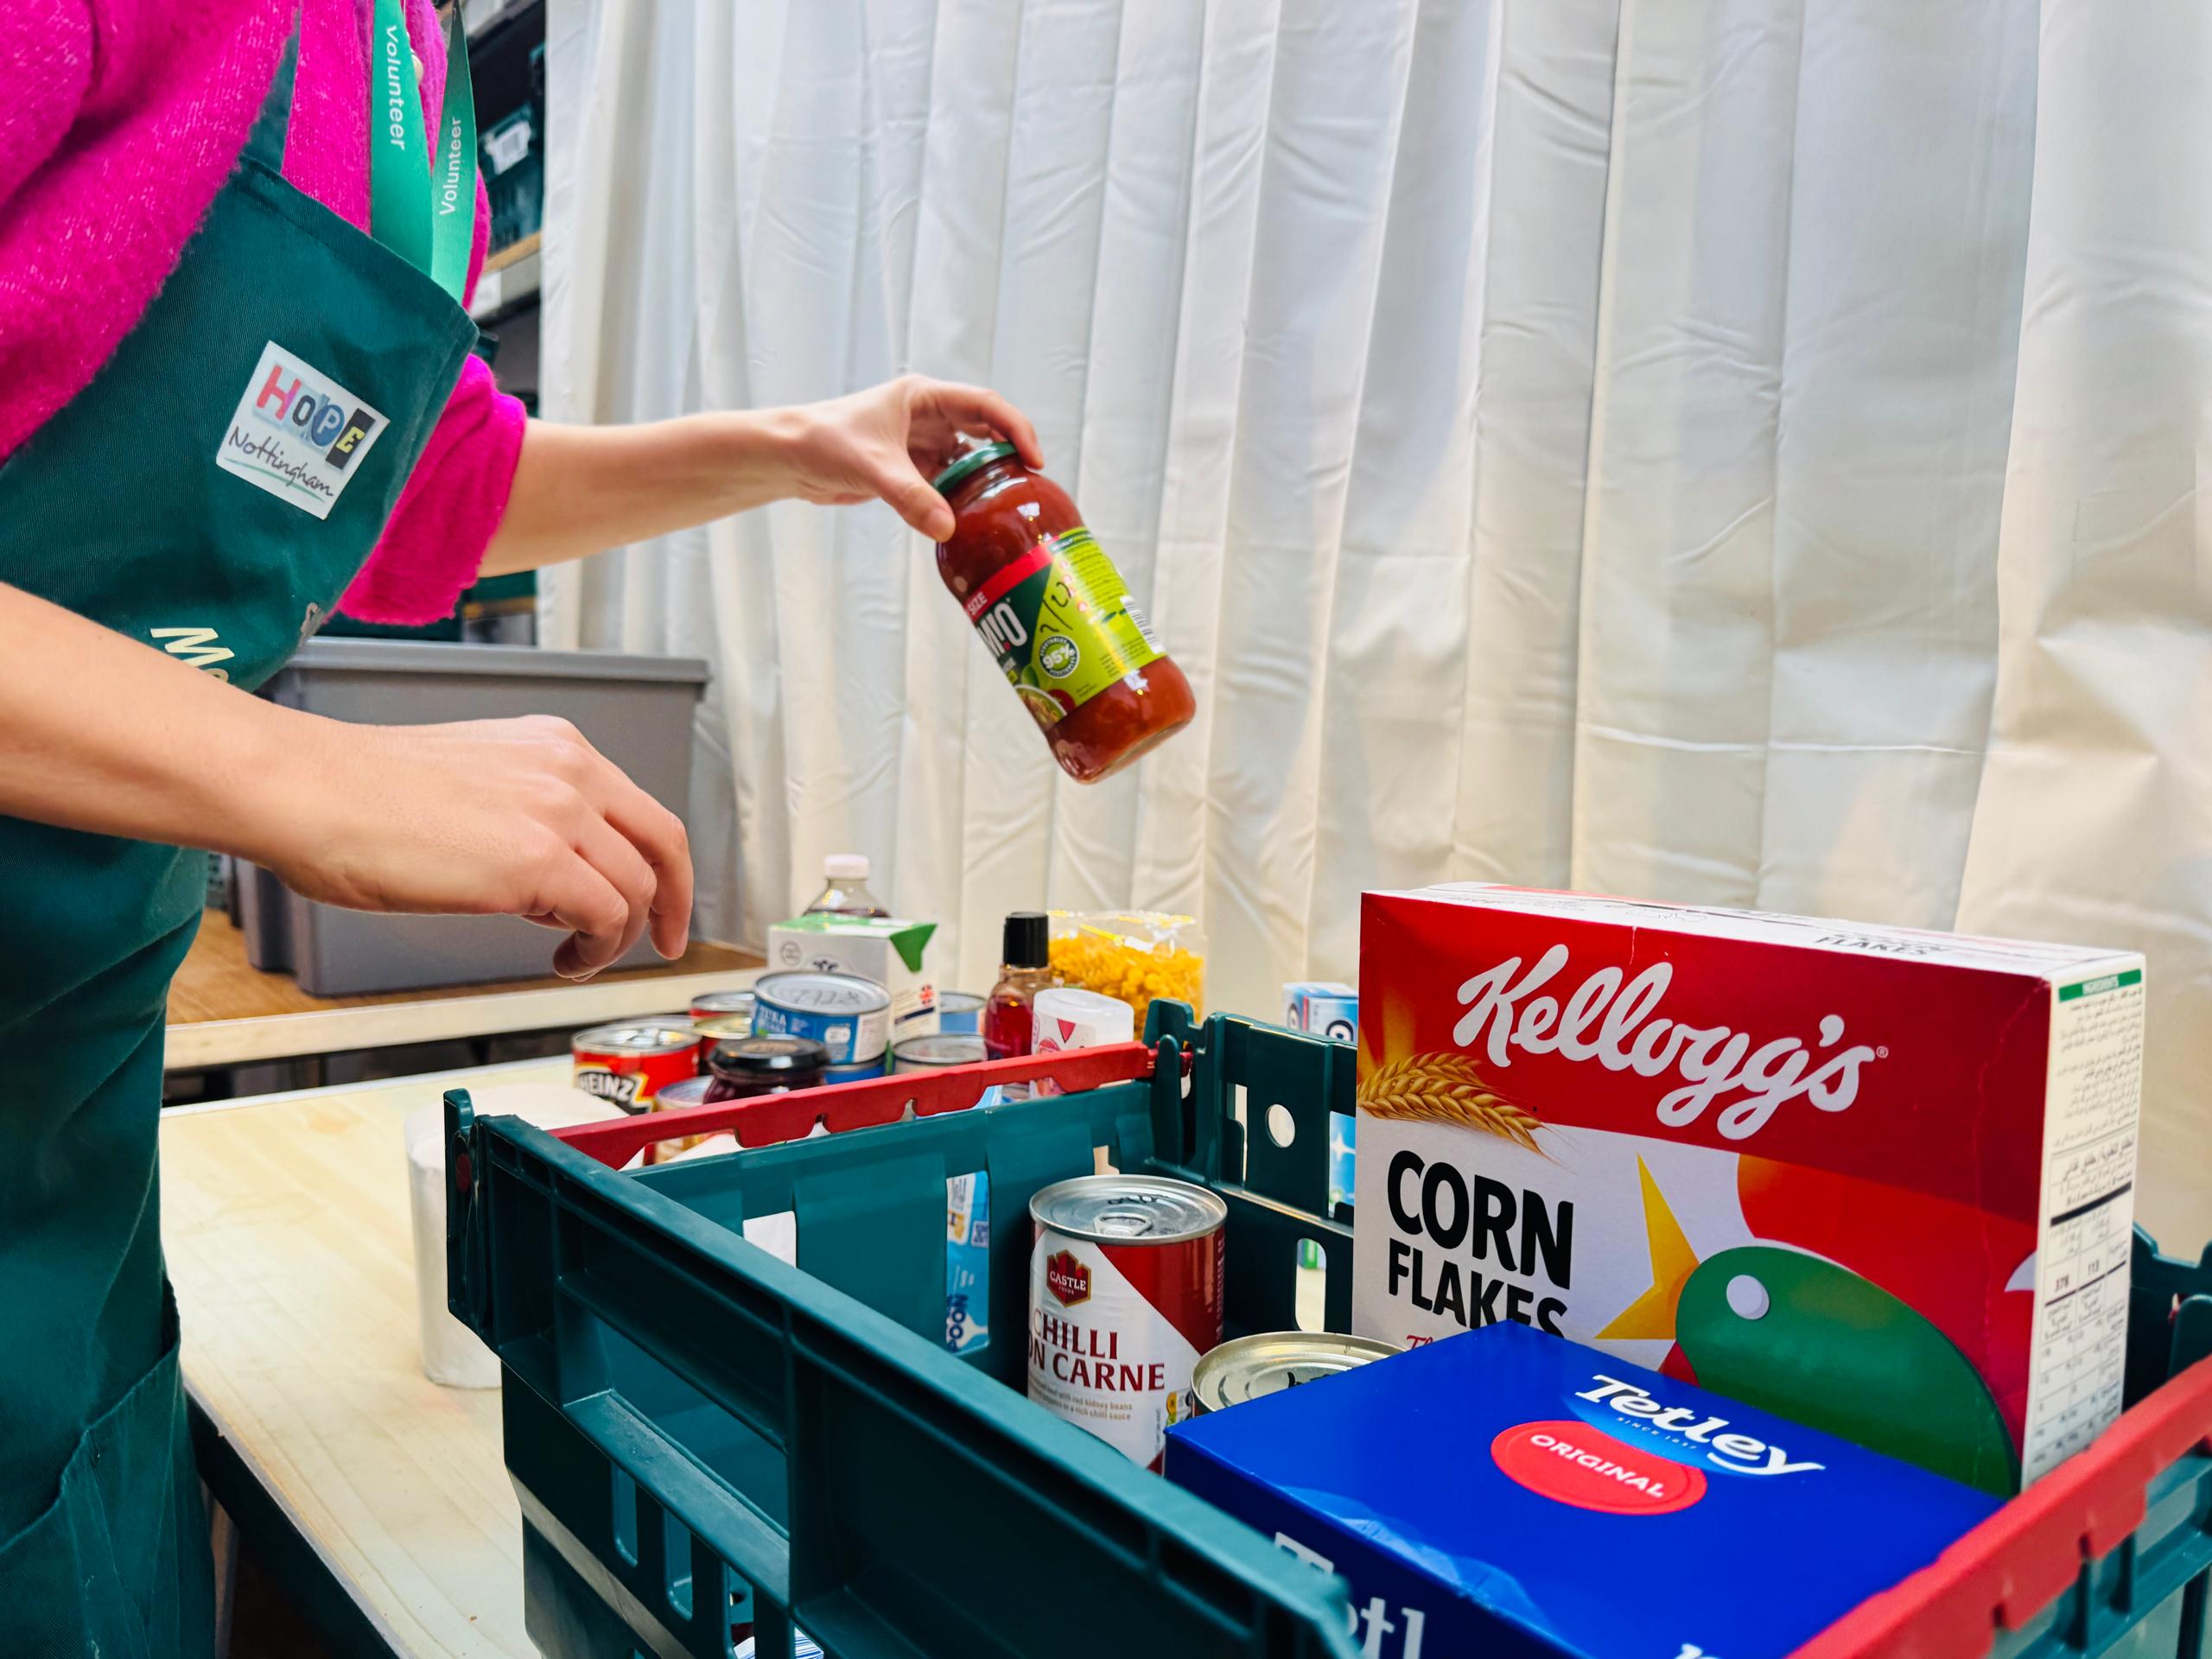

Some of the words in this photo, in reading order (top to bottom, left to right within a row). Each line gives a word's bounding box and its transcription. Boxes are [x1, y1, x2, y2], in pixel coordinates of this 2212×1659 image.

[385, 25, 407, 151] Volunteer
[439, 117, 463, 216] Volunteer
[256, 364, 366, 454] HOPE
[228, 426, 334, 497] Nottingham
[1042, 644, 1076, 670] 95%
[1452, 944, 1876, 1141] Kellogg's
[578, 1071, 634, 1102] HEINZ
[1387, 1150, 1574, 1290] CORN
[1049, 1270, 1087, 1292] CASTLE
[1388, 1237, 1568, 1341] FLAKES
[1033, 1307, 1118, 1360] CHILLI
[1052, 1351, 1165, 1392] CARNE
[1574, 1374, 1826, 1477] Tetley
[1529, 1433, 1665, 1500] ORIGINAL
